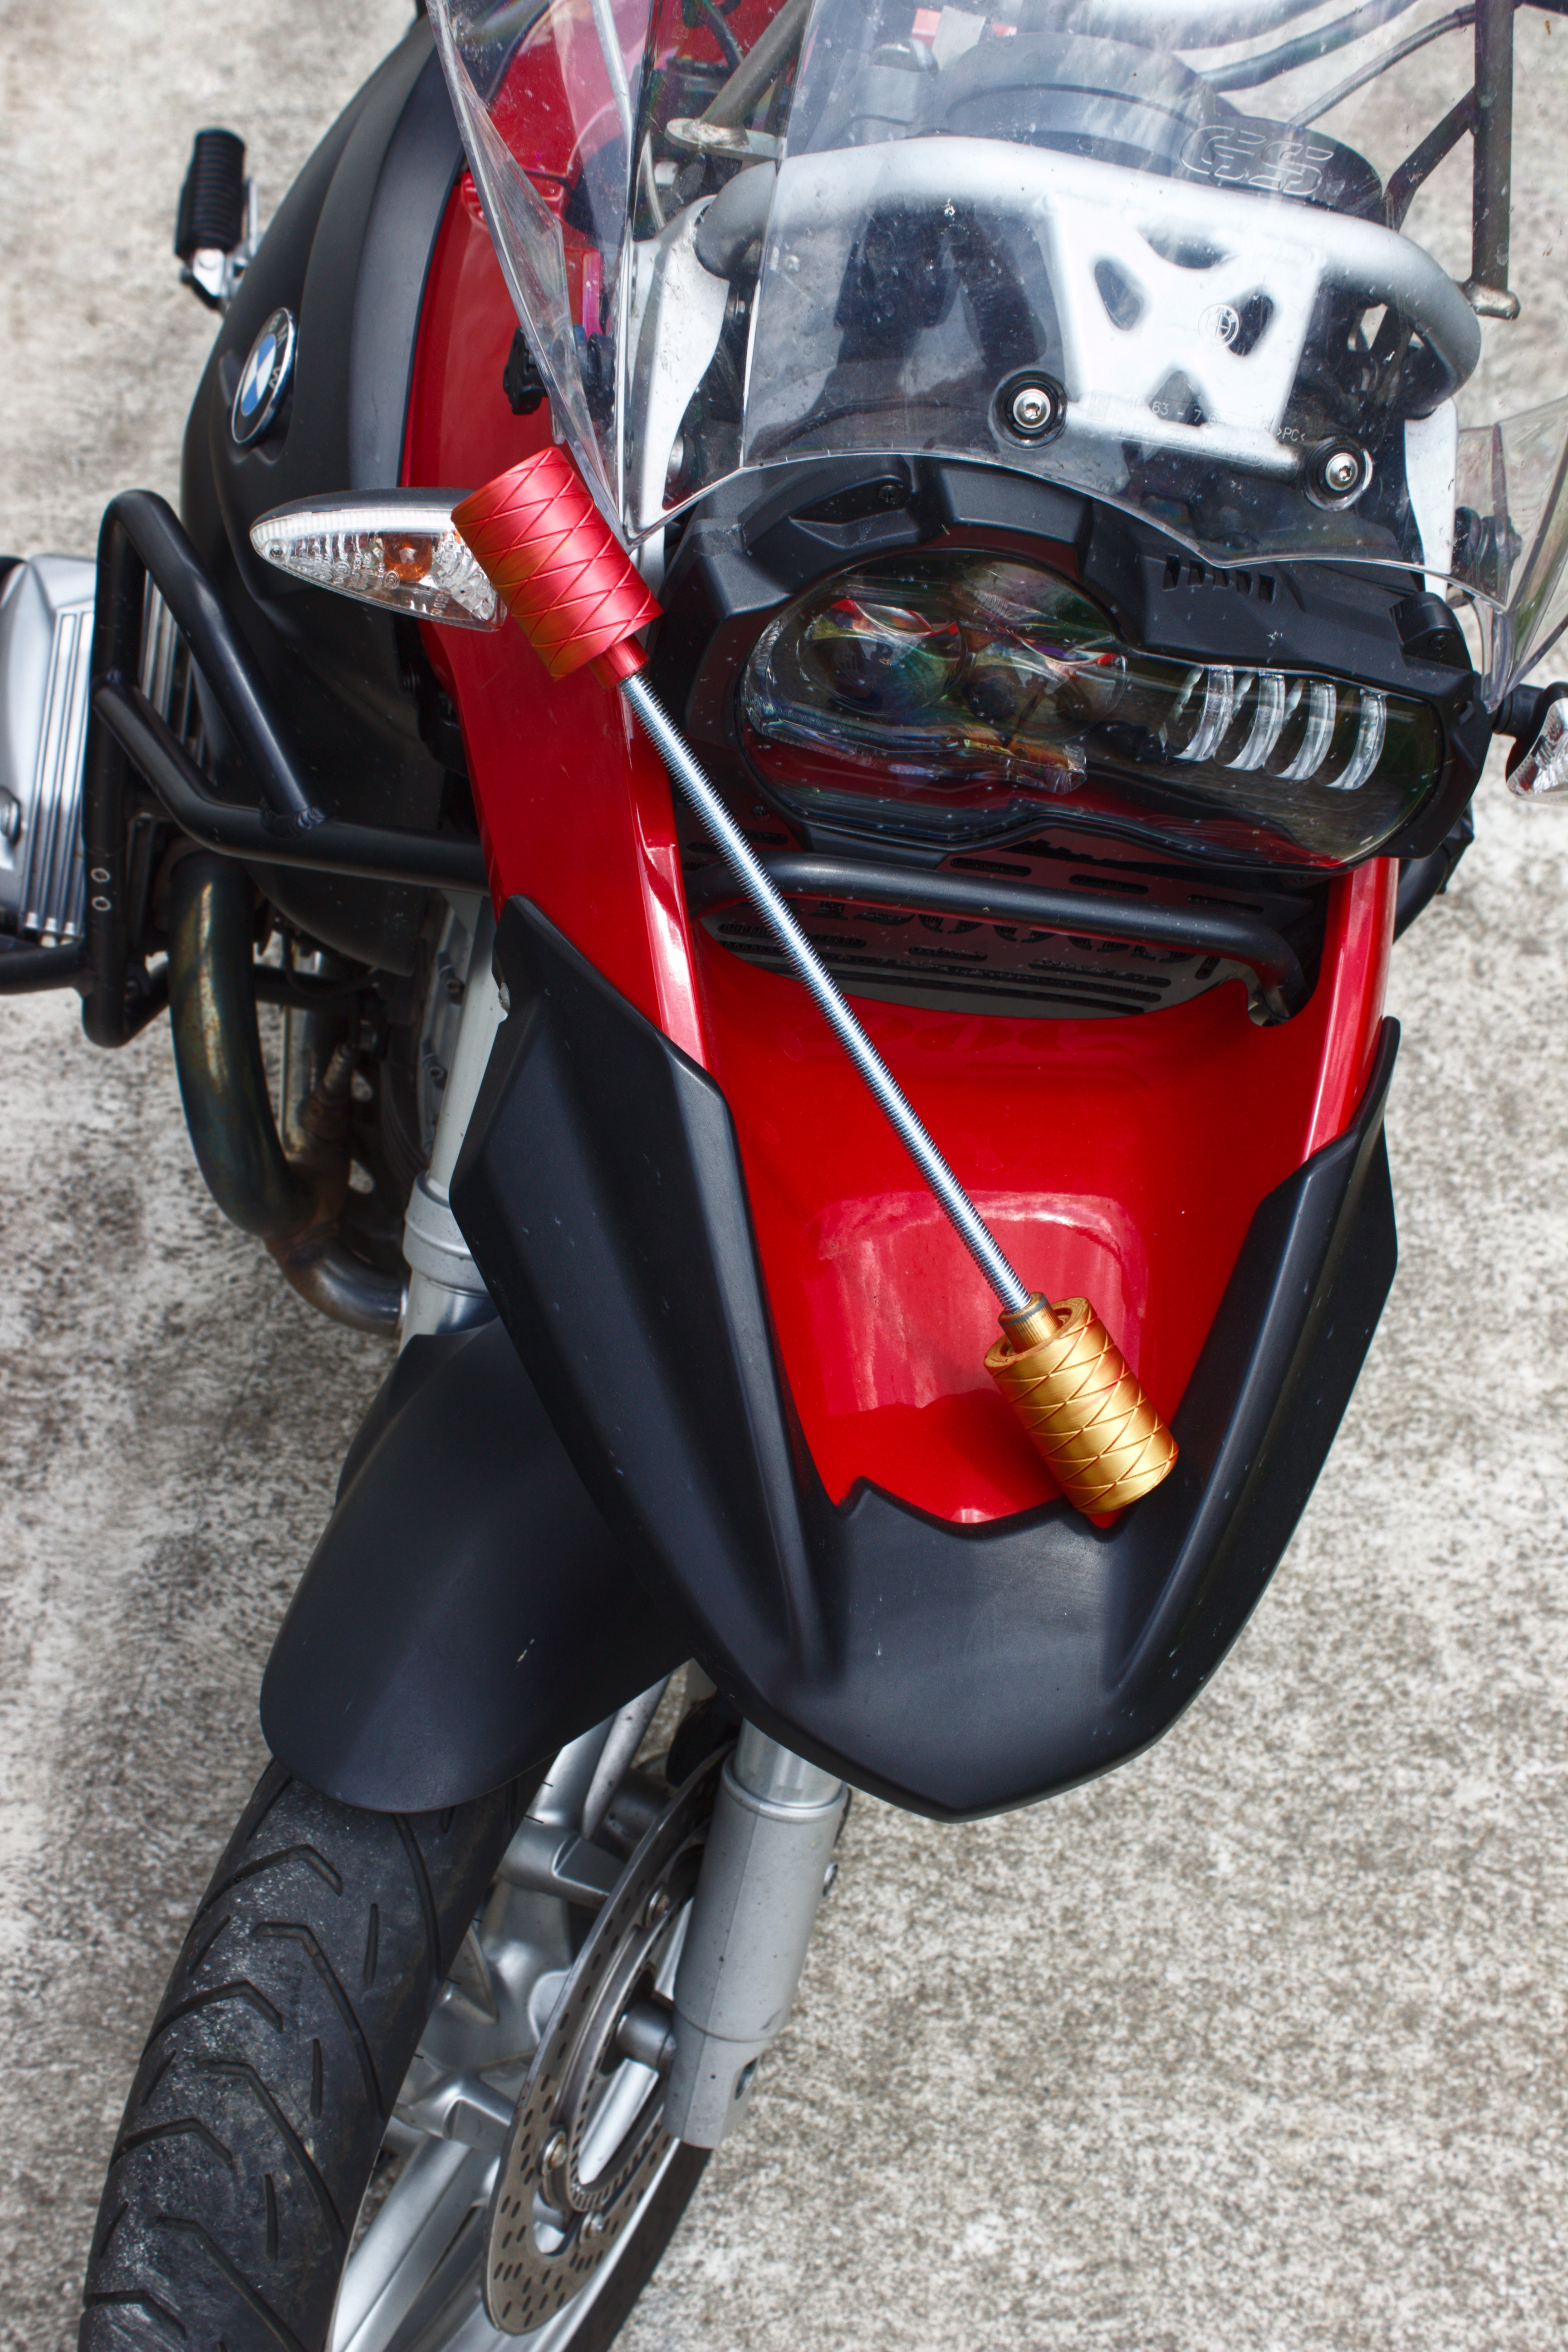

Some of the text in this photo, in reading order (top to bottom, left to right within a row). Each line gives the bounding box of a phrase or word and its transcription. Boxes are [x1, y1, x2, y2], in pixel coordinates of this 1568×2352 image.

[1181, 125, 1334, 196] GS
[269, 314, 288, 390] BMW
[1132, 421, 1159, 436] DOT
[1194, 408, 1201, 422] 7
